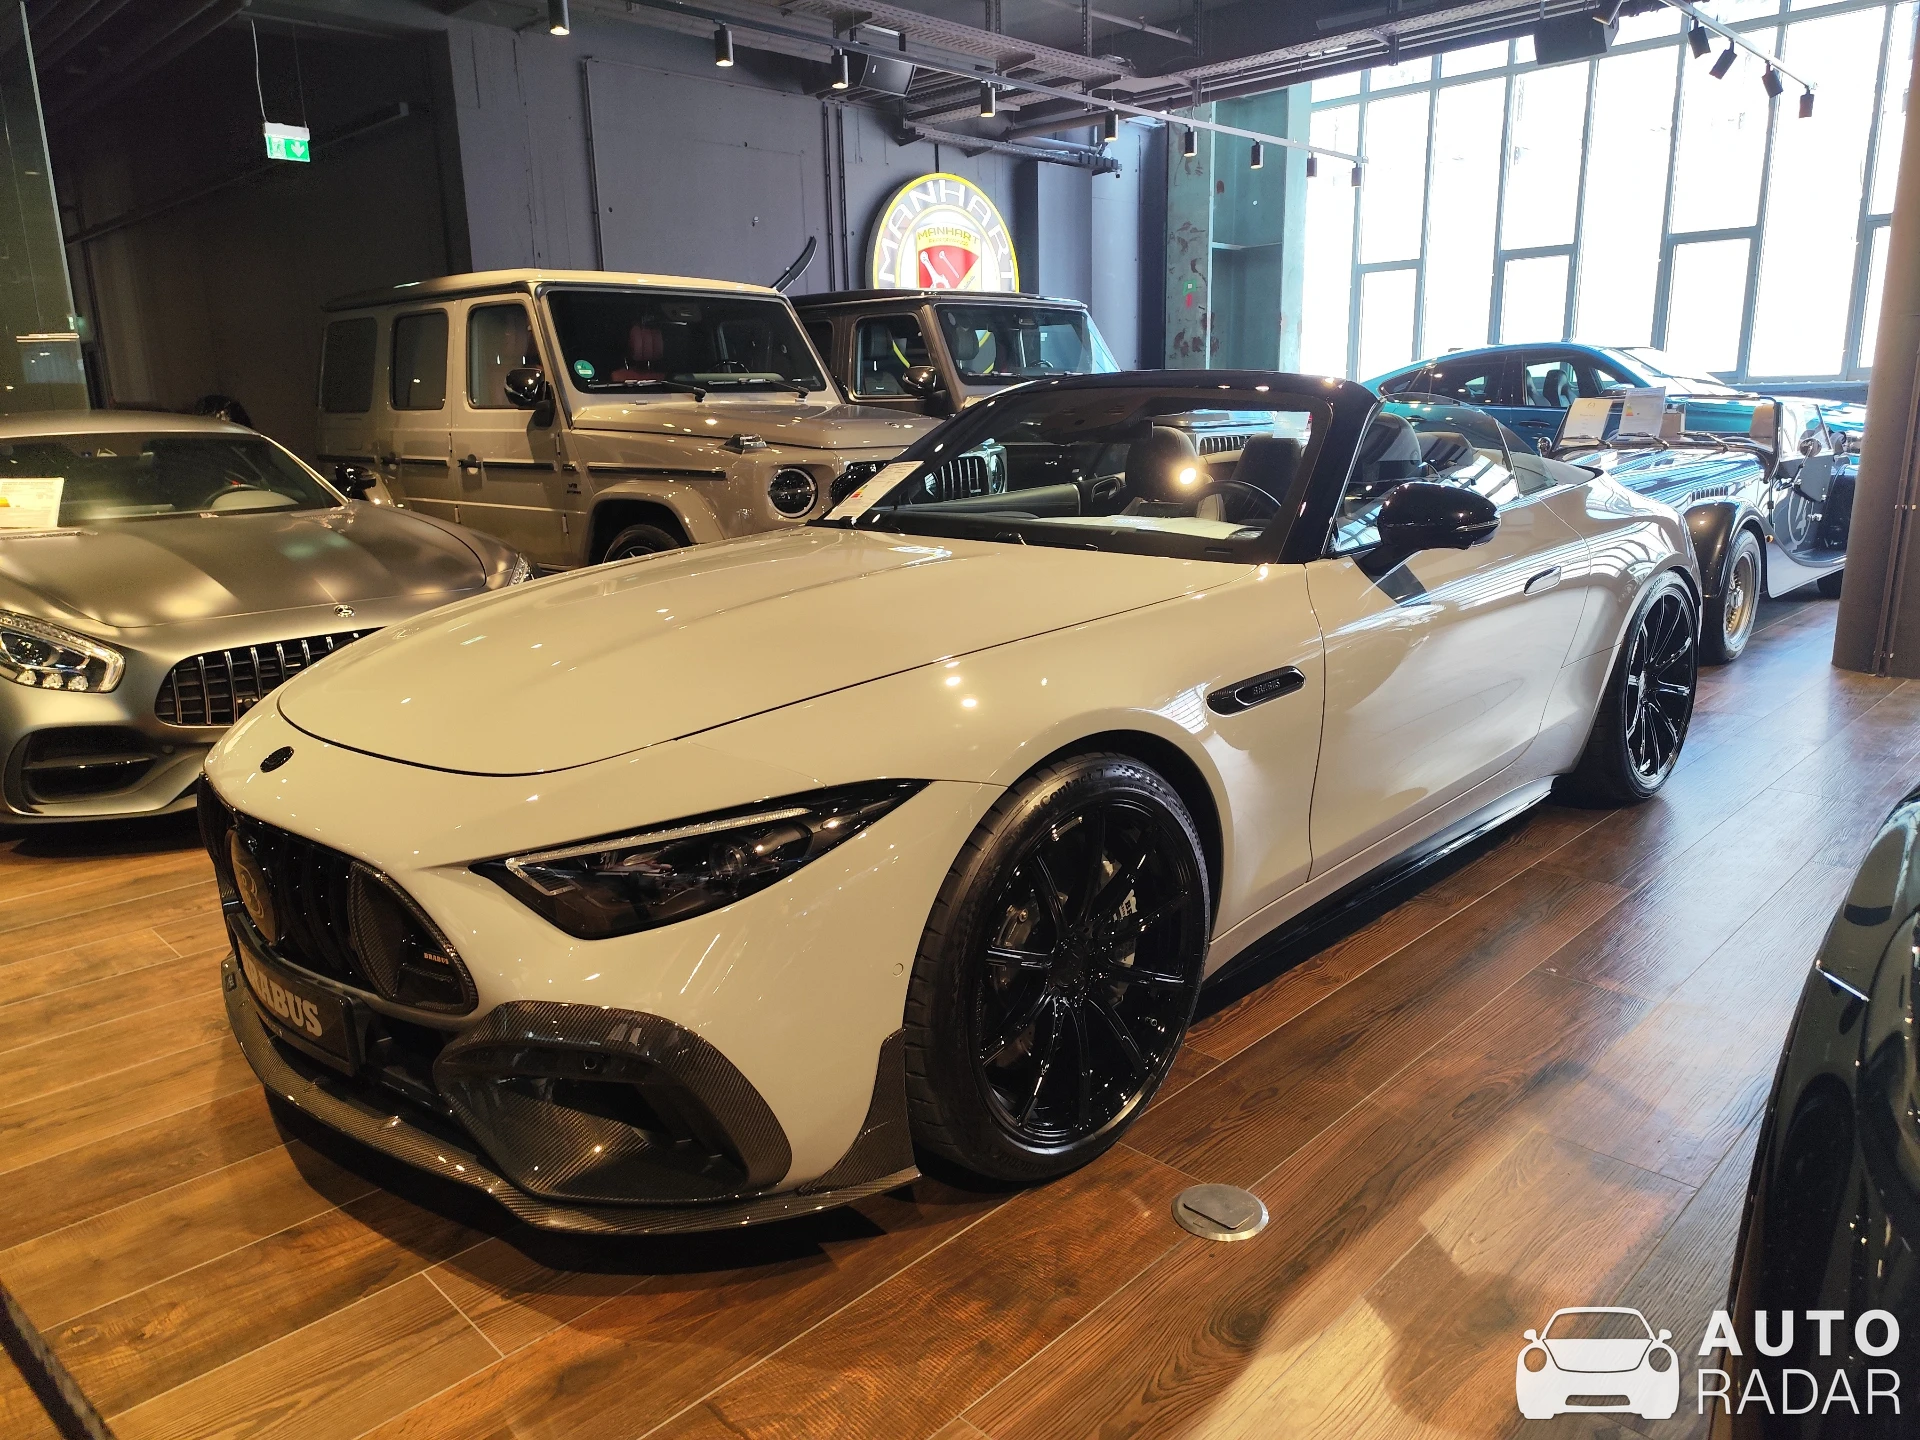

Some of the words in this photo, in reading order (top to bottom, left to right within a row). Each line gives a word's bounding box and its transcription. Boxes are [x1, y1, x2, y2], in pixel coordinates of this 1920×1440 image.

[878, 179, 1015, 291] MANHART
[917, 226, 980, 245] MANHART
[423, 952, 449, 965] BRABUS
